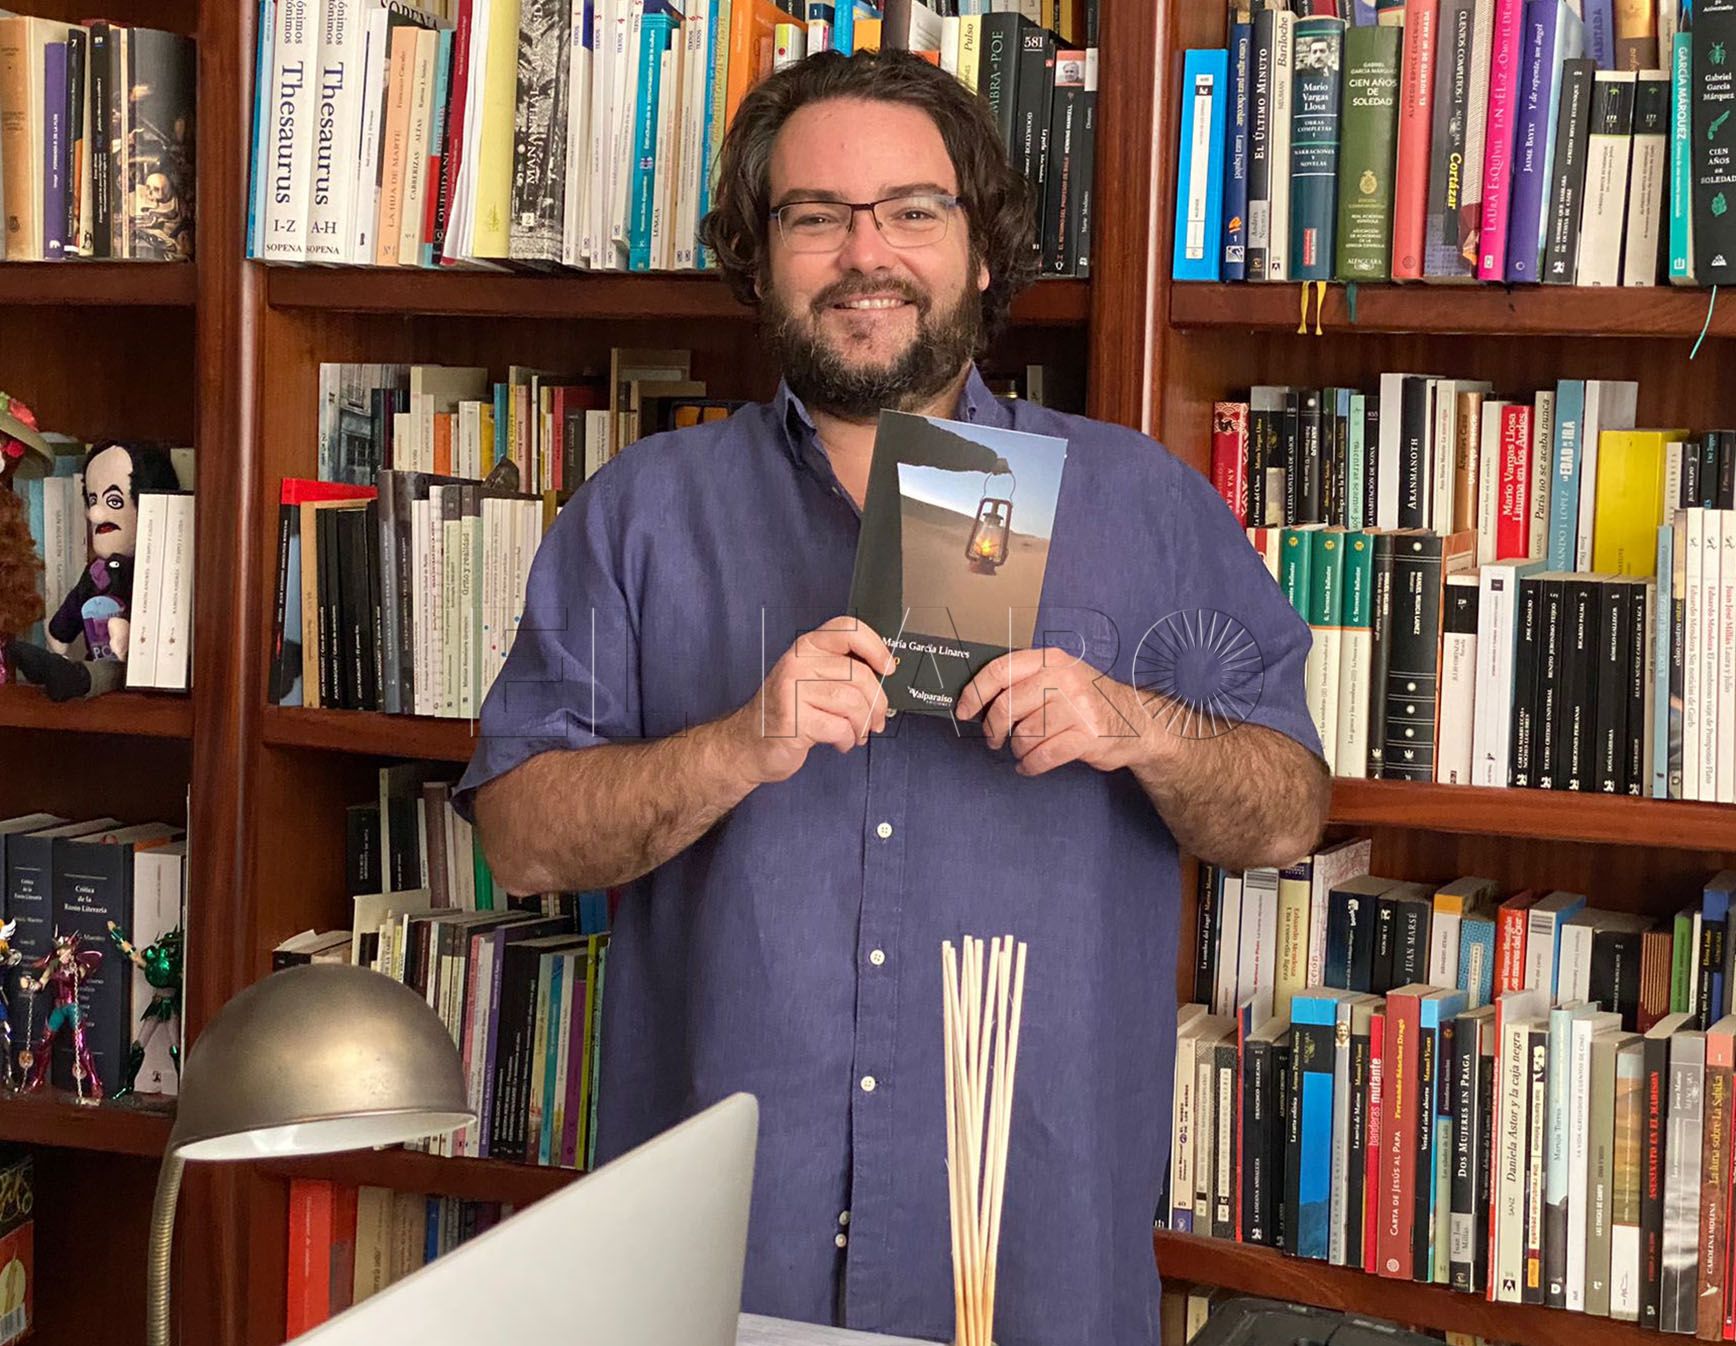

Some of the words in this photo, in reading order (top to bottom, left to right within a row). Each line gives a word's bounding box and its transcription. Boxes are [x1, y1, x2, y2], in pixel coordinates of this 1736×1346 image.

[964, 23, 974, 51] Pulso
[991, 31, 1003, 61] POE
[1024, 36, 1043, 48] 581
[1277, 17, 1288, 67] Bariloche
[1256, 48, 1267, 93] MINUTO
[1528, 93, 1537, 101] de
[1533, 23, 1544, 45] ángel
[1677, 46, 1688, 85] GARCÍA
[1303, 82, 1328, 91] Mario
[1349, 79, 1369, 87] CIEN
[1371, 77, 1397, 87] AÑOS
[1705, 72, 1732, 83] Gabriel
[1706, 82, 1731, 91] García
[1302, 93, 1328, 102] Vargas
[1353, 98, 1392, 106] SOLEDAD
[1367, 88, 1379, 96] DE
[1703, 90, 1735, 102] Márquez
[1252, 98, 1265, 140] ÚLTIMO
[1304, 103, 1326, 111] Llosa
[1676, 88, 1688, 140] MÁRQUEZ
[275, 61, 303, 204] Thesaurus
[315, 61, 344, 205] Thesaurus
[1523, 148, 1534, 172] JAIME
[1708, 147, 1729, 156] CIEN
[1708, 155, 1730, 165] AÑOS
[1448, 152, 1462, 210] Cortázar
[274, 219, 296, 232] I-Z
[311, 222, 336, 234] A-H
[266, 243, 301, 253] SOPENA
[1542, 399, 1550, 429] nunca
[1506, 413, 1516, 442] Llosa
[1514, 449, 1525, 464] los
[1539, 432, 1548, 463] acaba
[1407, 438, 1418, 509] ARANMANOTH
[1504, 444, 1517, 481] Vargas
[1516, 466, 1524, 482] en
[1539, 464, 1547, 475] se
[1537, 478, 1546, 492] no
[1503, 484, 1514, 516] Mario
[1512, 484, 1524, 521] Lituma
[1534, 494, 1545, 521] París
[882, 636, 907, 650] María
[909, 640, 937, 655] García
[939, 645, 970, 660] Linares
[1406, 912, 1417, 945] MARSÉ
[1405, 948, 1415, 972] JUAN
[1512, 1031, 1524, 1066] negra
[1369, 1058, 1382, 1103] mutante
[1461, 1053, 1471, 1086] PRAGA
[1509, 1067, 1522, 1087] caja
[1394, 1079, 1402, 1120] Fernando
[1461, 1089, 1470, 1104] EN
[1509, 1089, 1520, 1100] la
[1367, 1105, 1380, 1146] banderas
[1507, 1109, 1519, 1140] Astor
[1651, 1117, 1658, 1129] EL
[1712, 1108, 1722, 1119] La
[1393, 1131, 1401, 1153] PAPA
[1459, 1107, 1470, 1152] MUJERES
[1650, 1132, 1658, 1144] EN
[1711, 1120, 1721, 1146] sobre
[1393, 1155, 1400, 1165] AL
[1458, 1156, 1468, 1177] DOS
[1506, 1143, 1519, 1183] Daniela
[1390, 1167, 1401, 1192] JESÚS
[1649, 1147, 1659, 1200] ASESINATO
[1709, 1171, 1719, 1184] La
[1392, 1194, 1400, 1205] DE
[1390, 1207, 1399, 1236] CARTA
[1708, 1203, 1716, 1235] MOLINA
[1707, 1236, 1715, 1274] CAROLINA
